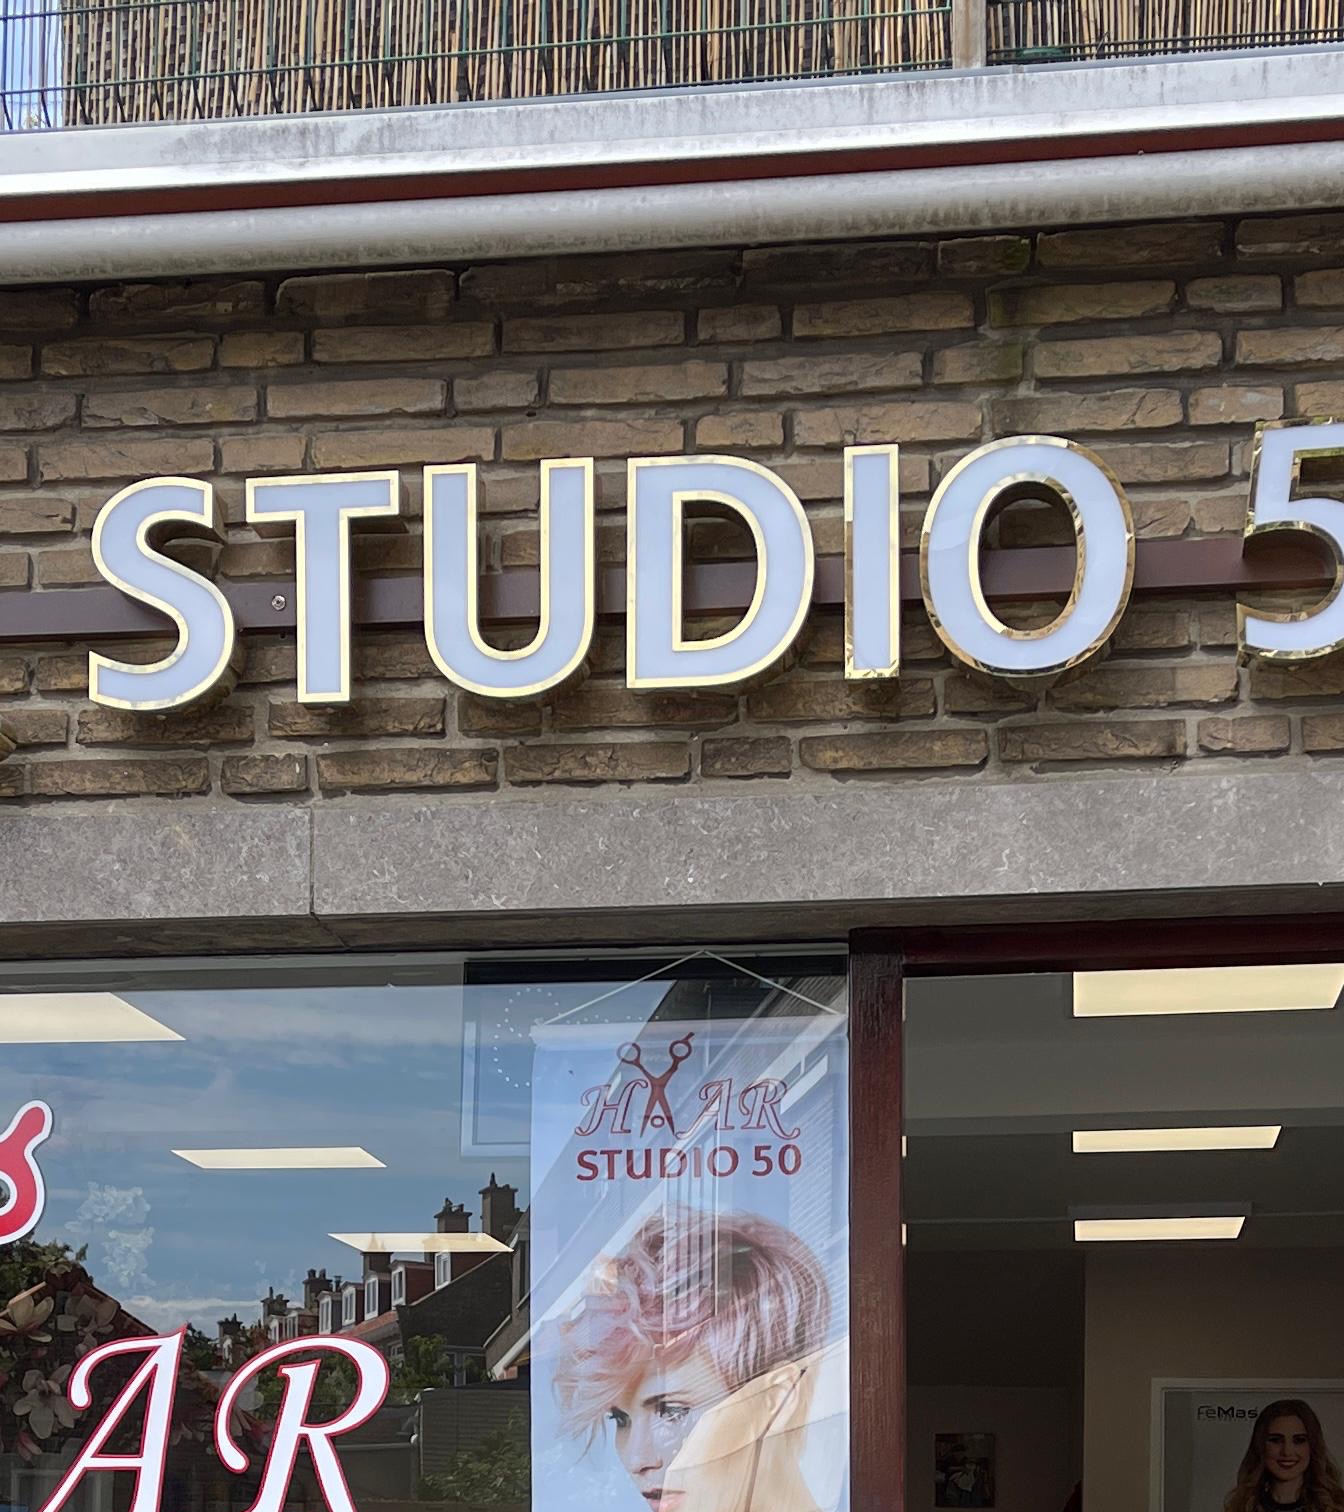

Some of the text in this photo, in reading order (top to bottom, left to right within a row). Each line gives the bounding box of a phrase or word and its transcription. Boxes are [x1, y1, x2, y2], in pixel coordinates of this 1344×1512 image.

[87, 434, 1136, 712] STUDIO
[576, 1143, 802, 1182] STUDIO 50
